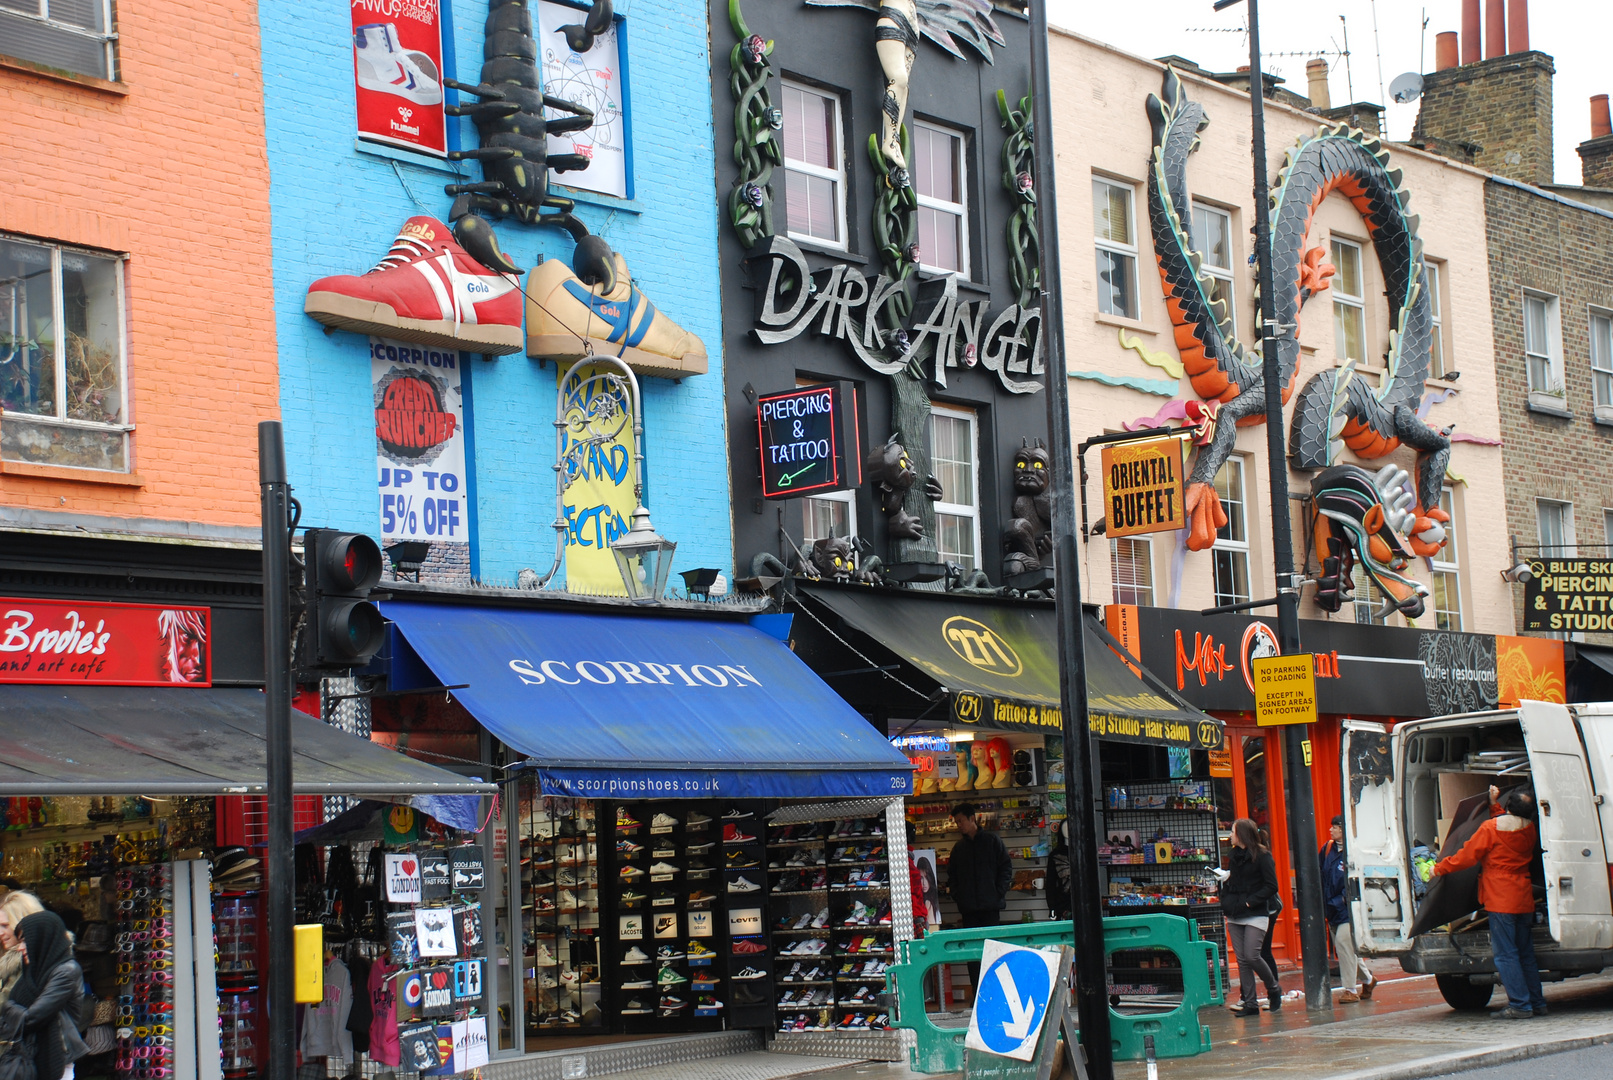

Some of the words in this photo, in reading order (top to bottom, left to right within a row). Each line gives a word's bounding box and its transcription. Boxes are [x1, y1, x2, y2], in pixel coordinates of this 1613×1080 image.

[390, 119, 420, 136] hummel
[402, 222, 436, 242] Gola
[467, 282, 490, 293] Gola
[600, 304, 620, 318] Gola
[755, 235, 905, 375] DARK
[903, 272, 1047, 394] ANGEL
[384, 377, 438, 412] CREDIT
[763, 393, 832, 422] PIERCING
[792, 419, 805, 438] &
[769, 439, 829, 464] TATTOO
[422, 471, 459, 493] TO
[1111, 456, 1174, 491] ORIENTAL
[379, 494, 417, 535] 5%
[423, 497, 460, 537] OFF
[1112, 487, 1175, 529] BUFFET
[1549, 561, 1587, 574] BLUE
[1589, 561, 1613, 574] SK
[1534, 595, 1548, 611] &
[0, 609, 111, 655] Brodie's
[1529, 621, 1541, 629] 277
[947, 627, 1017, 668] 271
[0, 654, 32, 672] and
[37, 657, 64, 672] art
[1175, 629, 1235, 692] Max
[508, 659, 763, 688] SCORPION
[1274, 665, 1306, 674] PARKING
[1274, 673, 1307, 682] LOADING
[1452, 667, 1496, 682] restaurant
[1259, 699, 1287, 708] SIGNED
[1289, 697, 1313, 706] AREAS
[1267, 691, 1294, 700] EXCEPT
[960, 694, 979, 718] 271
[1275, 706, 1311, 715] FOOTWAY
[993, 699, 1028, 724] Tattoo
[1028, 707, 1039, 725] &
[1164, 721, 1191, 742] Salon
[1201, 724, 1217, 744] 271
[908, 734, 951, 752] PIERCING
[542, 777, 720, 793] www.scorpionshoes.co.uk
[890, 776, 906, 789] 269
[393, 861, 399, 876] I
[392, 878, 419, 894] LONDON
[424, 878, 436, 886] FAST
[658, 917, 671, 926] NIKE
[620, 928, 642, 936] LACOSTE
[424, 973, 433, 989] I
[423, 989, 451, 1008] LONDON
